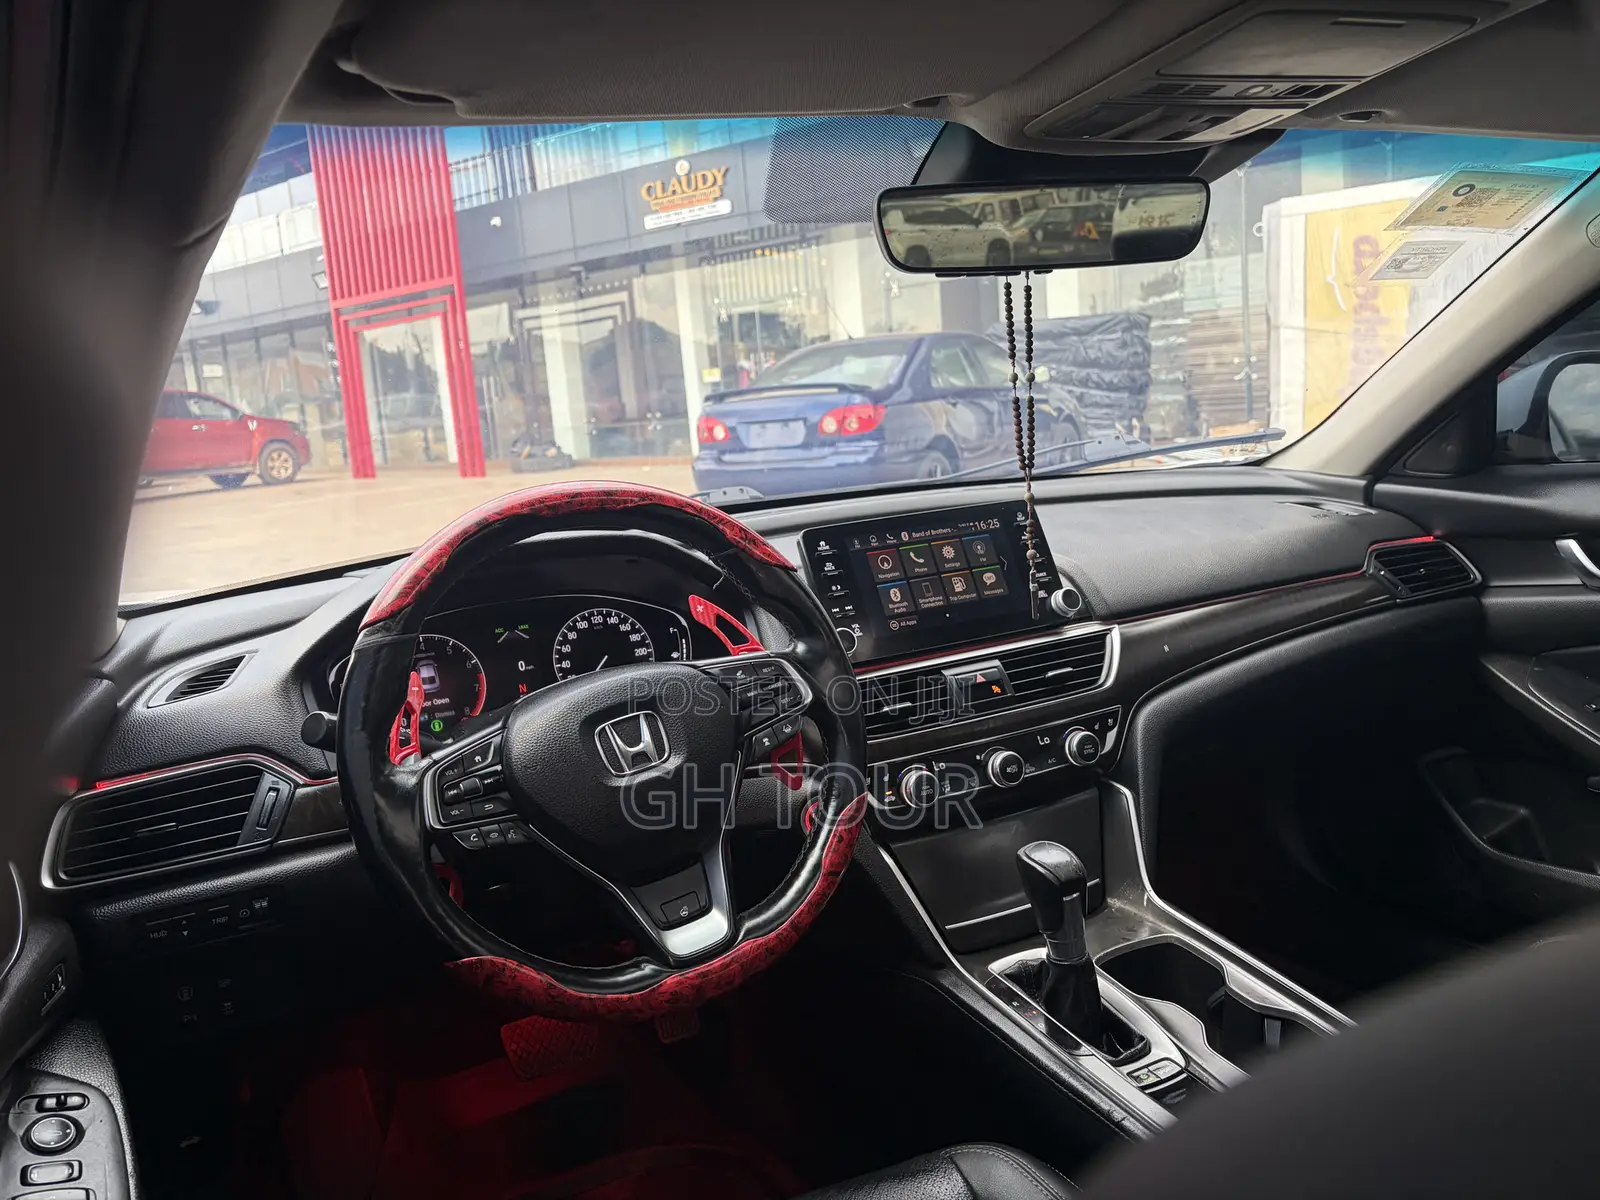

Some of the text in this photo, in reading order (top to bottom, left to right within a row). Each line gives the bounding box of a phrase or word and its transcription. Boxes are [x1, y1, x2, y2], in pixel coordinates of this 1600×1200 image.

[641, 166, 729, 202] CLAUDY
[975, 518, 1000, 531] 16:25
[878, 571, 900, 579] Navigation
[983, 588, 1004, 596] Messages
[919, 595, 943, 603] Smartphone
[921, 601, 943, 609] Connection
[590, 615, 603, 624] 120
[606, 616, 619, 625] 140
[576, 620, 589, 629] 100
[619, 623, 631, 632] 160
[567, 631, 577, 640] 80
[628, 633, 641, 643] 180
[446, 646, 453, 655] 5
[561, 644, 571, 653] 60
[634, 648, 648, 657] 200
[466, 661, 472, 669] 6
[518, 660, 526, 671] 0
[561, 660, 571, 668] 40
[519, 684, 527, 693] N
[433, 697, 450, 705] Open
[1037, 735, 1050, 745] Lo
[932, 761, 946, 771] Lo
[212, 916, 228, 925] TRIP
[150, 930, 168, 939] HUD
